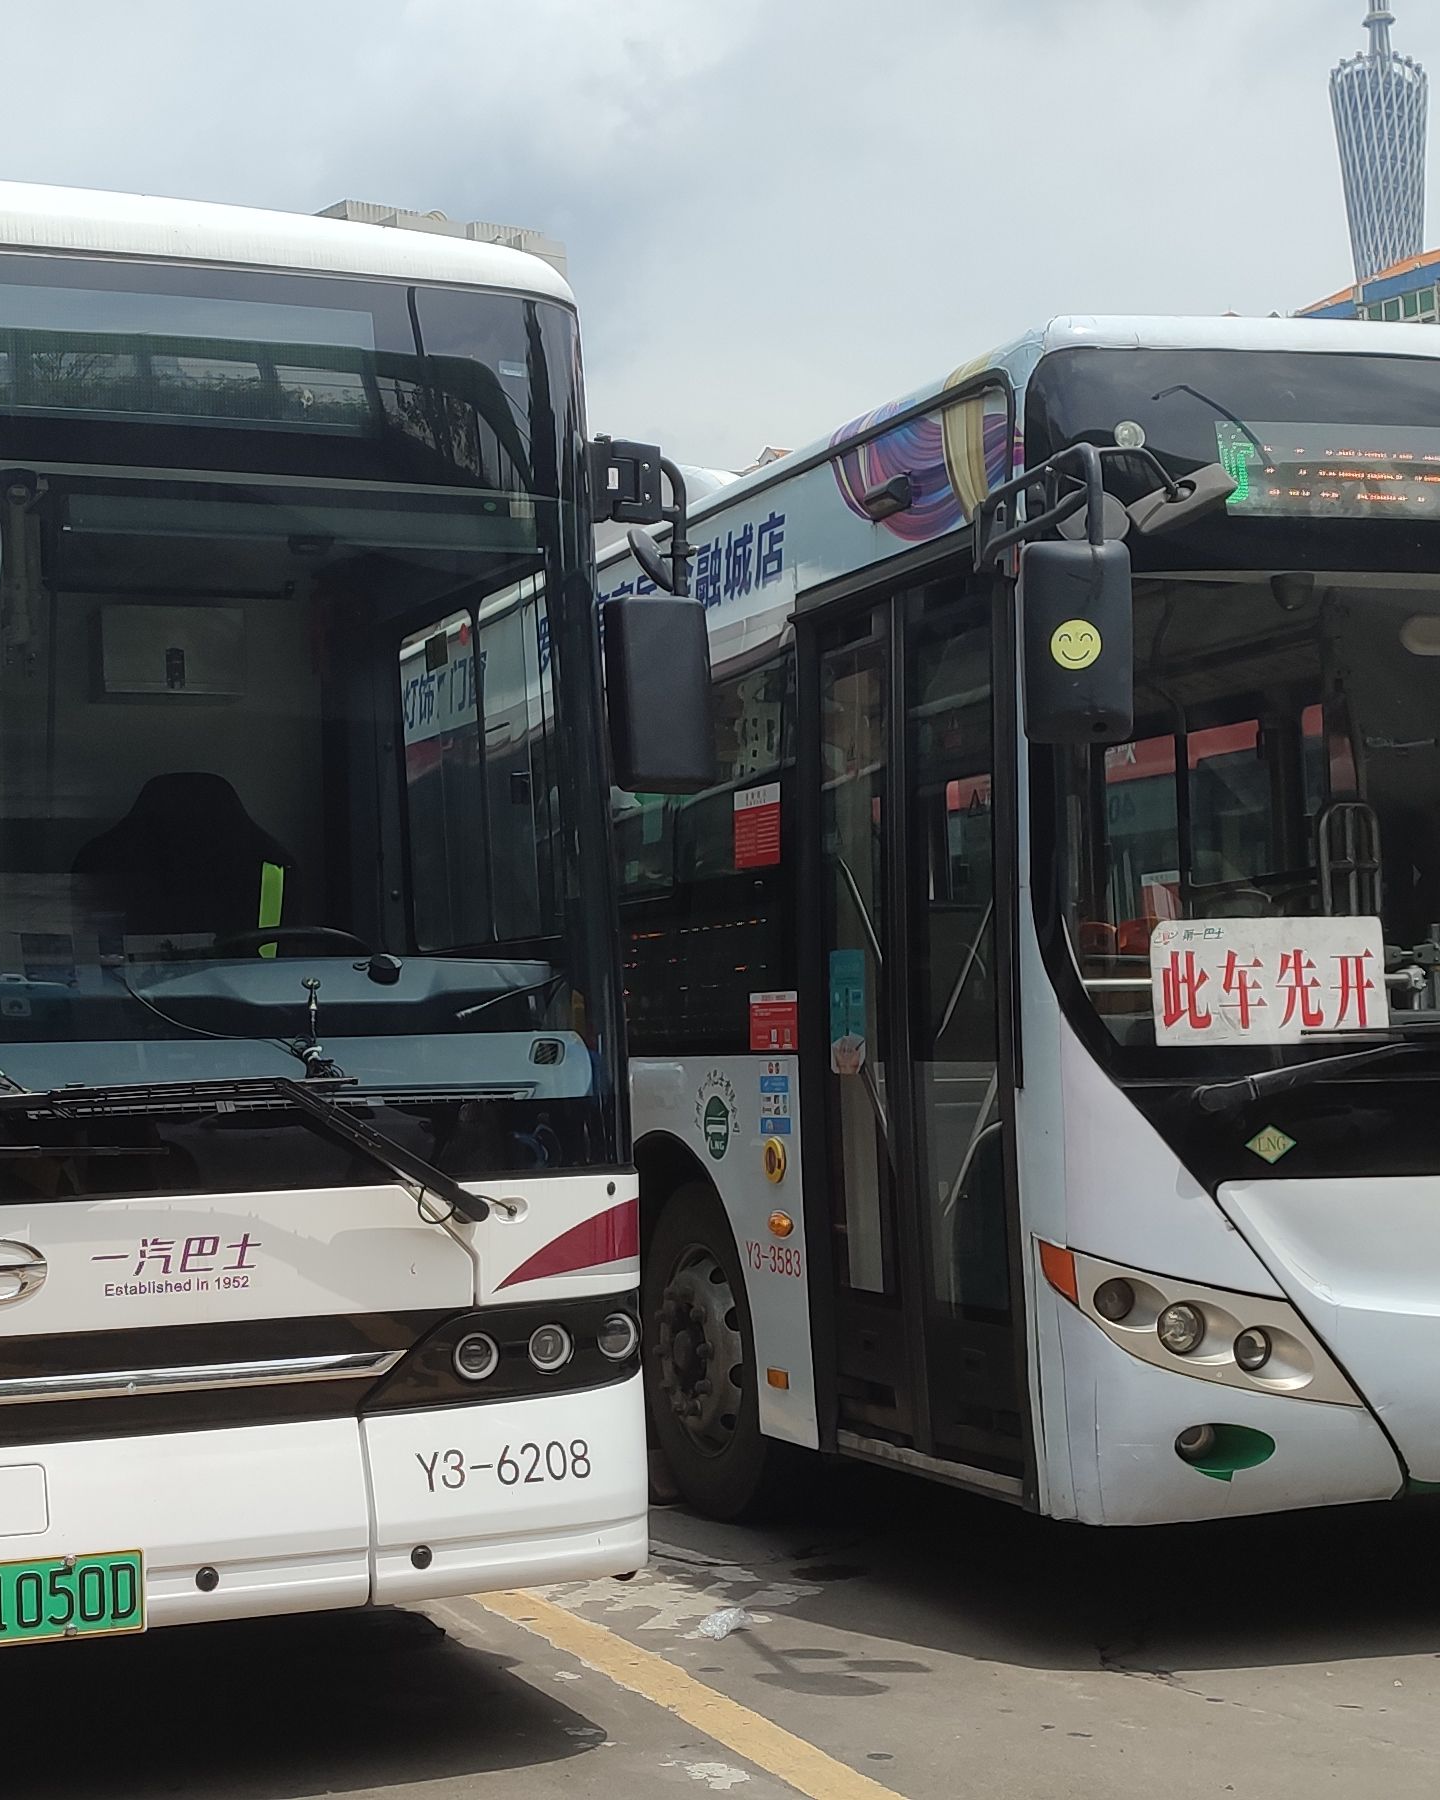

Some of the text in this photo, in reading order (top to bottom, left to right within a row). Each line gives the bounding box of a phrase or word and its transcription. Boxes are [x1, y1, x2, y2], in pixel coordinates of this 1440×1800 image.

[686, 511, 787, 611] 融城店
[1162, 947, 1375, 1030] 此车先开
[1258, 1136, 1286, 1152] LNG
[91, 1233, 262, 1277] 一汽巴士
[745, 1240, 802, 1277] Y3-3583
[104, 1279, 192, 1297] Established
[215, 1276, 250, 1290] 1952
[414, 1439, 591, 1493] Y3-6208
